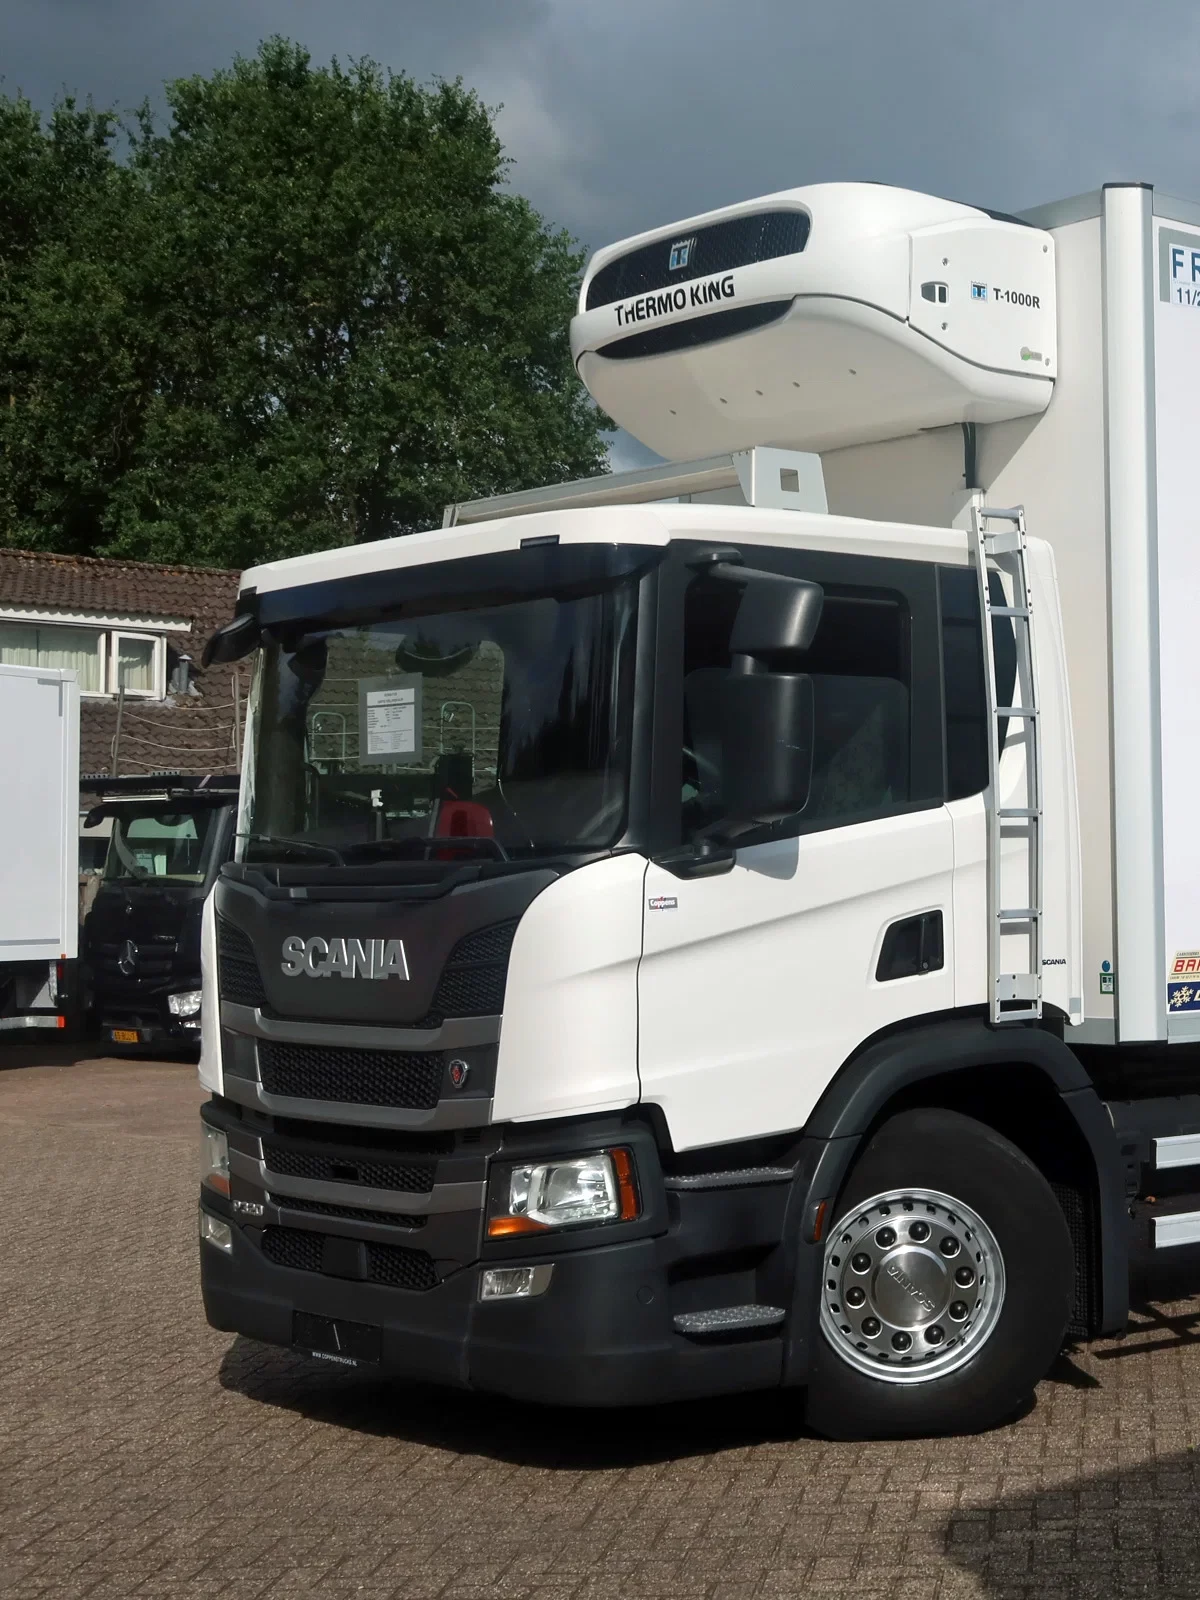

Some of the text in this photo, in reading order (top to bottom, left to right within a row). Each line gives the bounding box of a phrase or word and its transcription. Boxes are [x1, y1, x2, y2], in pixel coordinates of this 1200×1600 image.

[614, 275, 735, 326] THERMO KING
[993, 287, 1041, 309] T-1000R
[281, 936, 410, 981] SCANIA
[1042, 958, 1067, 966] SCANIA
